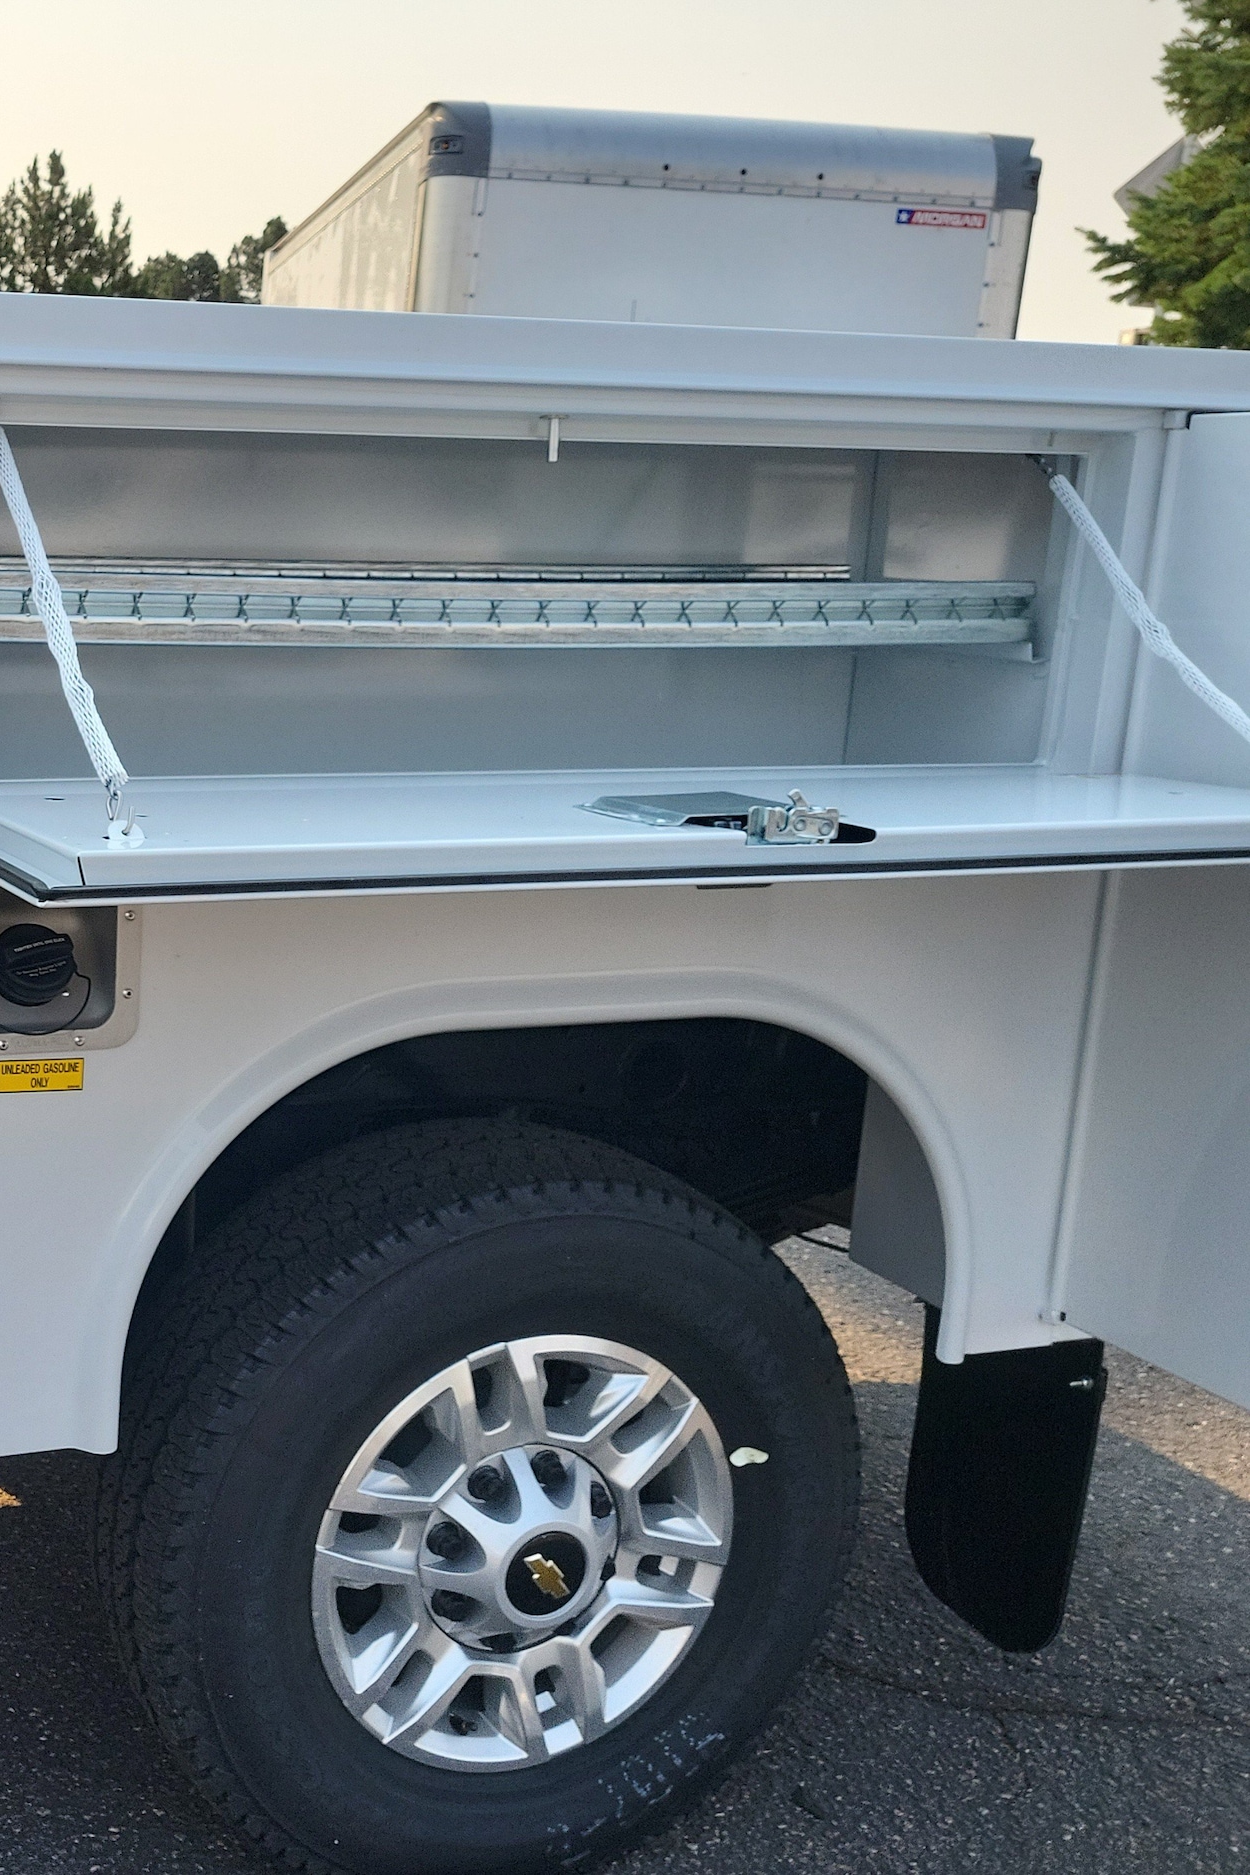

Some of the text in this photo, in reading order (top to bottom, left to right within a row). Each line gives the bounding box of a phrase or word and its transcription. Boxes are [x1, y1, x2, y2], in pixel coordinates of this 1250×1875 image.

[911, 210, 985, 227] MORGAN
[1, 1062, 80, 1075] UNLEADED GASOLINE
[30, 1077, 50, 1088] ONLY
